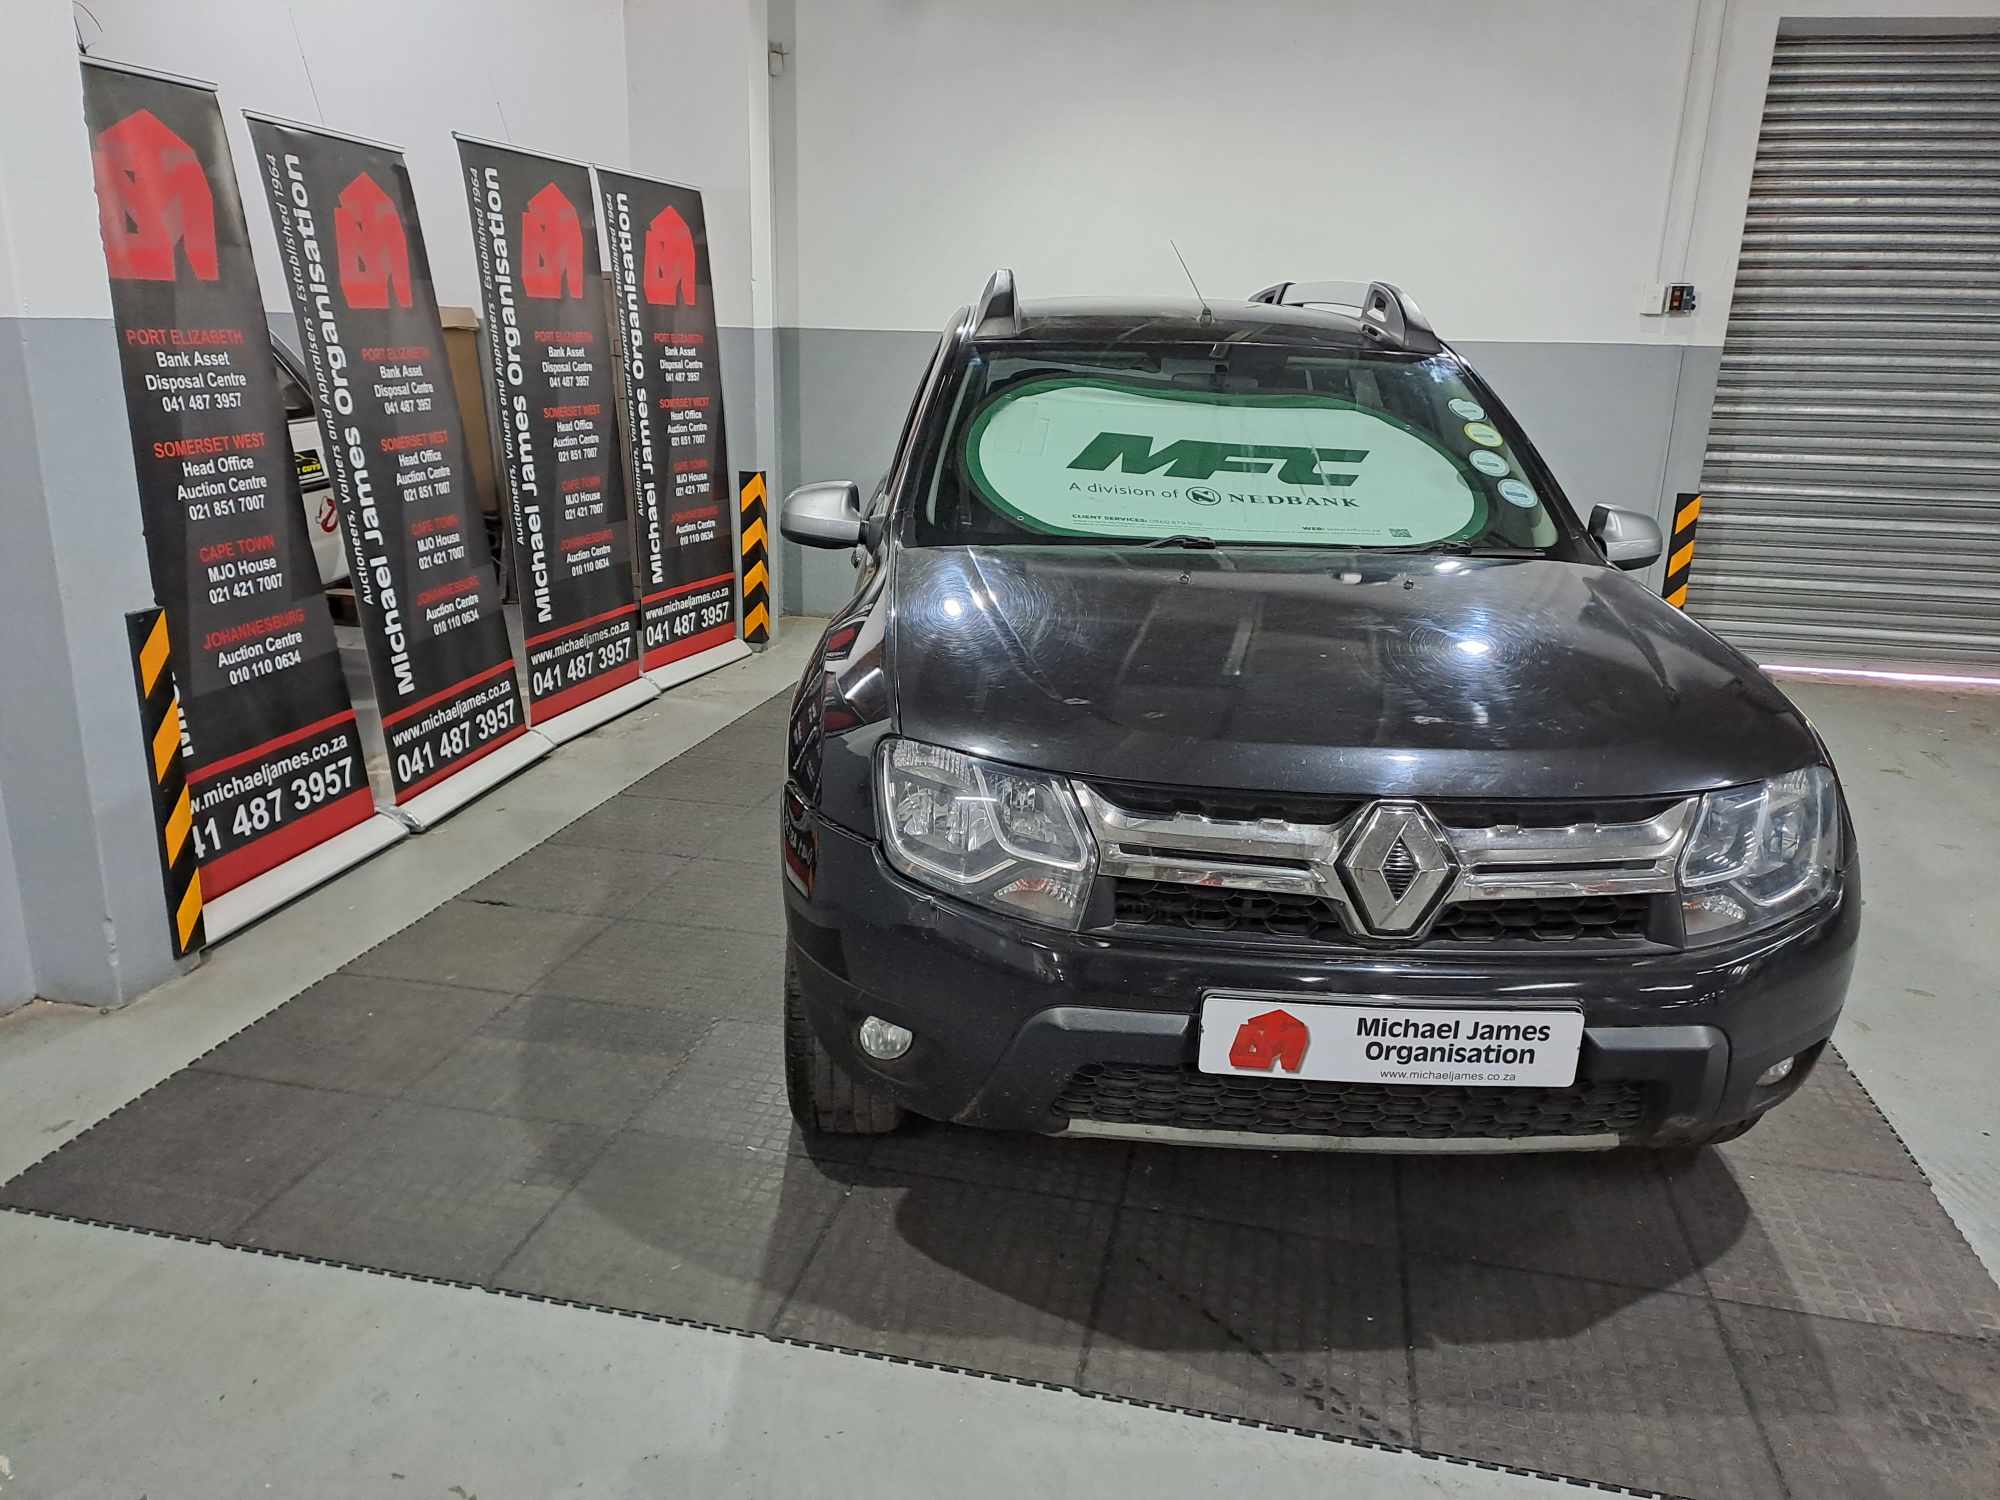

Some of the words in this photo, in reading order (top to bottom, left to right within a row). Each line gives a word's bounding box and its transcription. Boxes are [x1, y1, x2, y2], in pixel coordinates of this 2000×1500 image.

[285, 153, 353, 416] Organisation
[484, 167, 523, 386] Organisation
[616, 192, 644, 380] Organisation
[126, 329, 167, 345] PORT
[170, 329, 244, 345] ELIZABETH
[156, 351, 192, 368] Bank
[193, 350, 231, 366] Asset
[304, 316, 330, 405] Appraisers
[380, 365, 401, 379] Bank
[145, 372, 204, 393] Disposal
[206, 371, 247, 388] Centre
[374, 382, 410, 399] Disposal
[162, 396, 185, 413] 041
[188, 394, 211, 411] 487
[214, 392, 241, 409] 3957
[384, 402, 399, 415] 041
[322, 408, 338, 440] and
[636, 387, 654, 475] James
[153, 435, 230, 458] SOMERSET
[232, 432, 265, 449] WEST
[419, 449, 442, 463] Office
[513, 395, 537, 497] James
[1066, 431, 1371, 487] MFC
[182, 458, 216, 477] Head
[217, 455, 254, 473] Office
[332, 444, 351, 504] Valuers
[396, 471, 427, 486] Auction
[427, 466, 451, 480] Centre
[177, 481, 227, 501] Auction
[228, 475, 268, 493] Centre
[344, 426, 383, 546] James
[403, 487, 418, 502] 021
[419, 485, 433, 499] 851
[1068, 481, 1082, 492] A
[1087, 482, 1155, 498] division
[1160, 488, 1178, 499] of
[1227, 493, 1360, 508] NEDBANK
[189, 502, 212, 521] 021
[213, 498, 236, 517] 851
[238, 494, 265, 512] 7007
[643, 482, 664, 584] Michael
[200, 541, 236, 562] CAPE
[418, 555, 433, 570] 021
[433, 552, 447, 565] 421
[524, 504, 552, 623] Michael
[208, 562, 236, 583] MJO
[238, 557, 277, 576] House
[209, 586, 230, 604] 021
[233, 580, 254, 598] 421
[257, 573, 283, 592] 7007
[370, 555, 415, 696] Michael
[426, 603, 454, 621] Auction
[433, 621, 447, 636] 010
[447, 616, 461, 631] 110
[646, 620, 670, 647] 041
[673, 611, 697, 636] 487
[700, 601, 730, 628] 3957
[218, 643, 264, 668] Auction
[265, 632, 303, 652] Centre
[530, 621, 630, 665] www.michaeljames.co.za
[229, 667, 250, 685] 010
[252, 658, 273, 678] 110
[275, 650, 302, 670] 0634
[532, 663, 562, 696] 041
[567, 651, 594, 681] 487
[597, 636, 631, 669] 3957
[392, 680, 511, 748] www.michaeljames.co.za
[397, 741, 435, 783] 041
[440, 721, 470, 759] 487
[475, 698, 515, 740] 3957
[190, 734, 348, 816] w.michaeljames.co.za
[191, 817, 221, 859] 41
[232, 788, 282, 837] 487
[291, 756, 352, 811] 3957
[1356, 1017, 1460, 1040] Michael
[1466, 1021, 1551, 1042] James
[1365, 1041, 1536, 1065] Organisation
[1380, 1070, 1516, 1082] www.michaeljames.co.za
